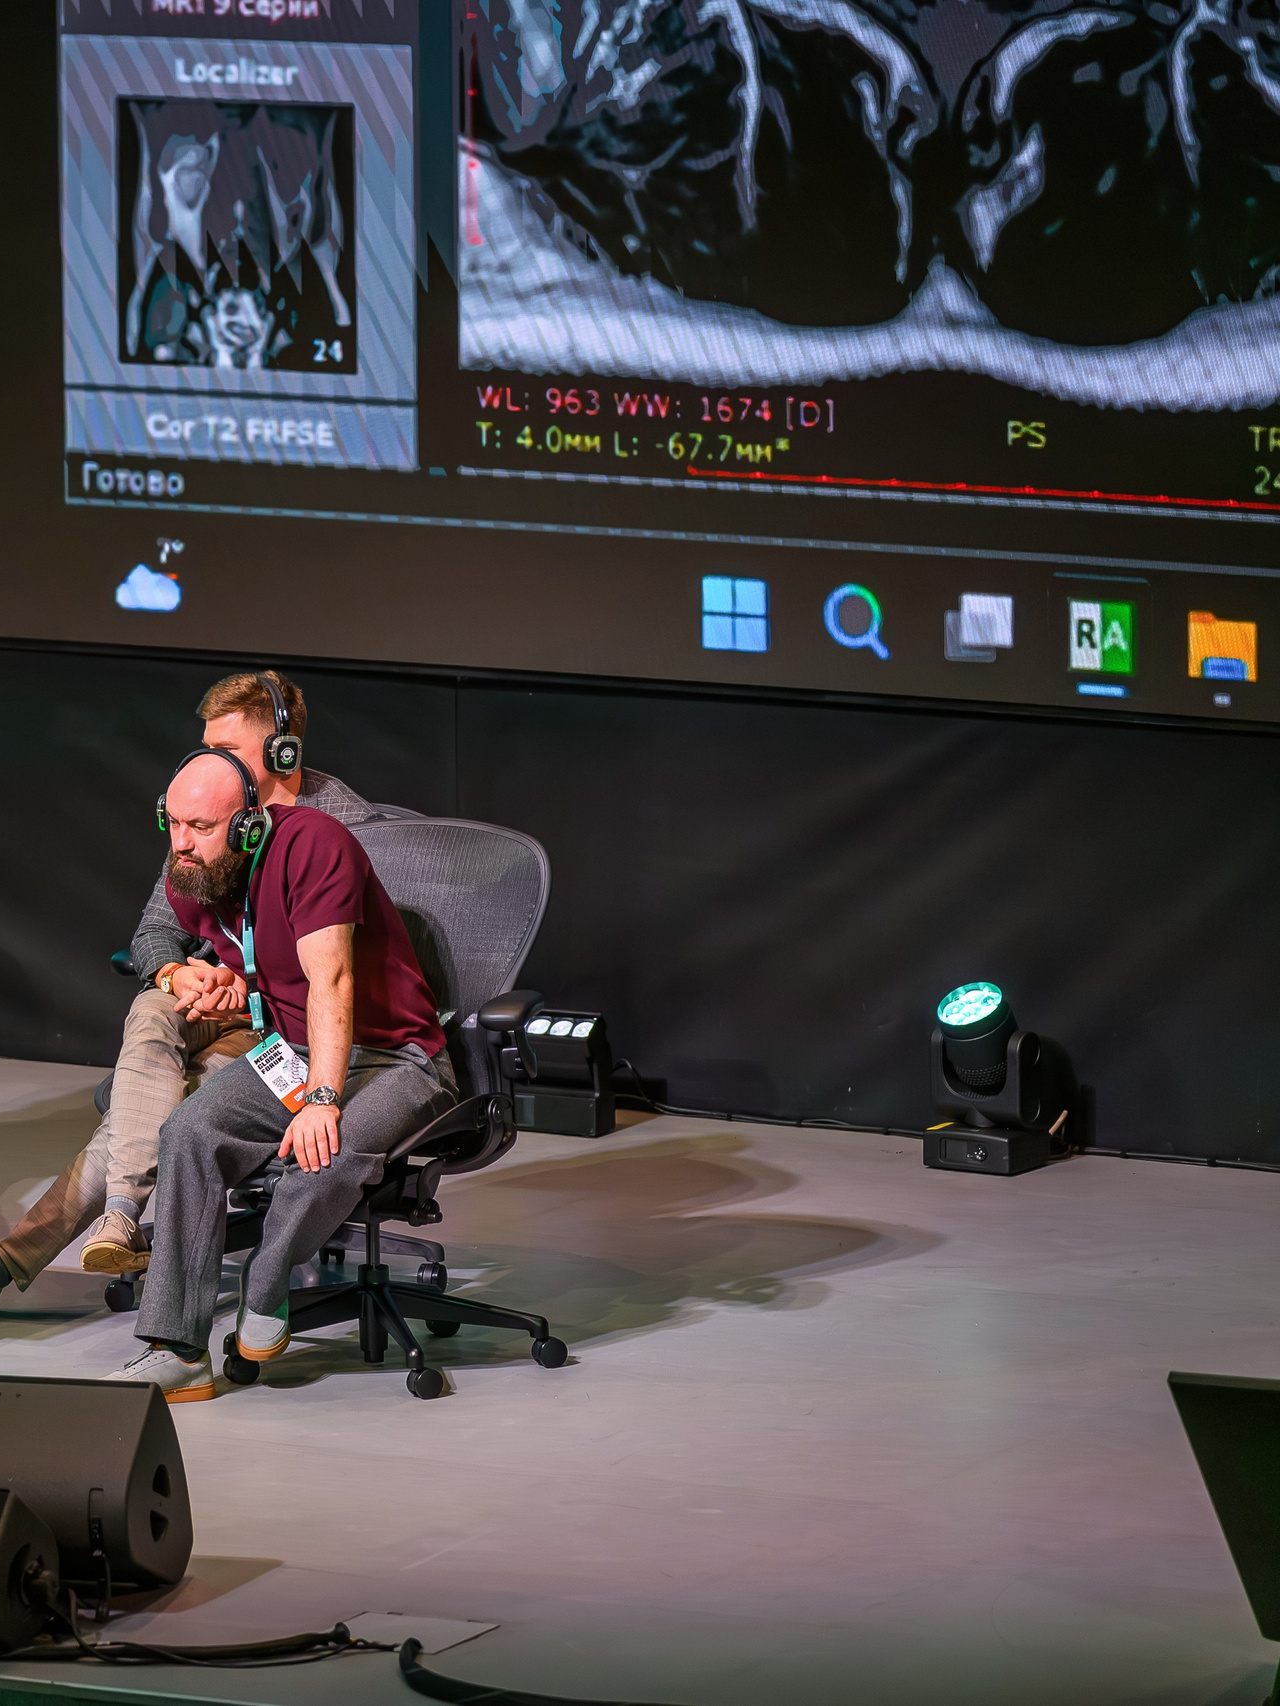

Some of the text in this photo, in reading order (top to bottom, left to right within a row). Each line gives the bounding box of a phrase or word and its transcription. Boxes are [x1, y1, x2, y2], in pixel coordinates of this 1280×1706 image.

[175, 56, 300, 86] Localizer
[477, 385, 530, 411] WL:
[546, 387, 600, 415] 963
[614, 391, 681, 419] WW:
[701, 396, 772, 423] 1674
[147, 413, 335, 447] Cor T2 FRFSE
[475, 421, 501, 449] T:
[614, 431, 639, 457] L:
[1007, 420, 1047, 448] PS
[82, 460, 186, 498] Готово
[1077, 618, 1130, 651] RA
[253, 1042, 283, 1066] MEDICAL
[257, 1050, 283, 1070] GLOBAL
[260, 1055, 285, 1075] FORUM
